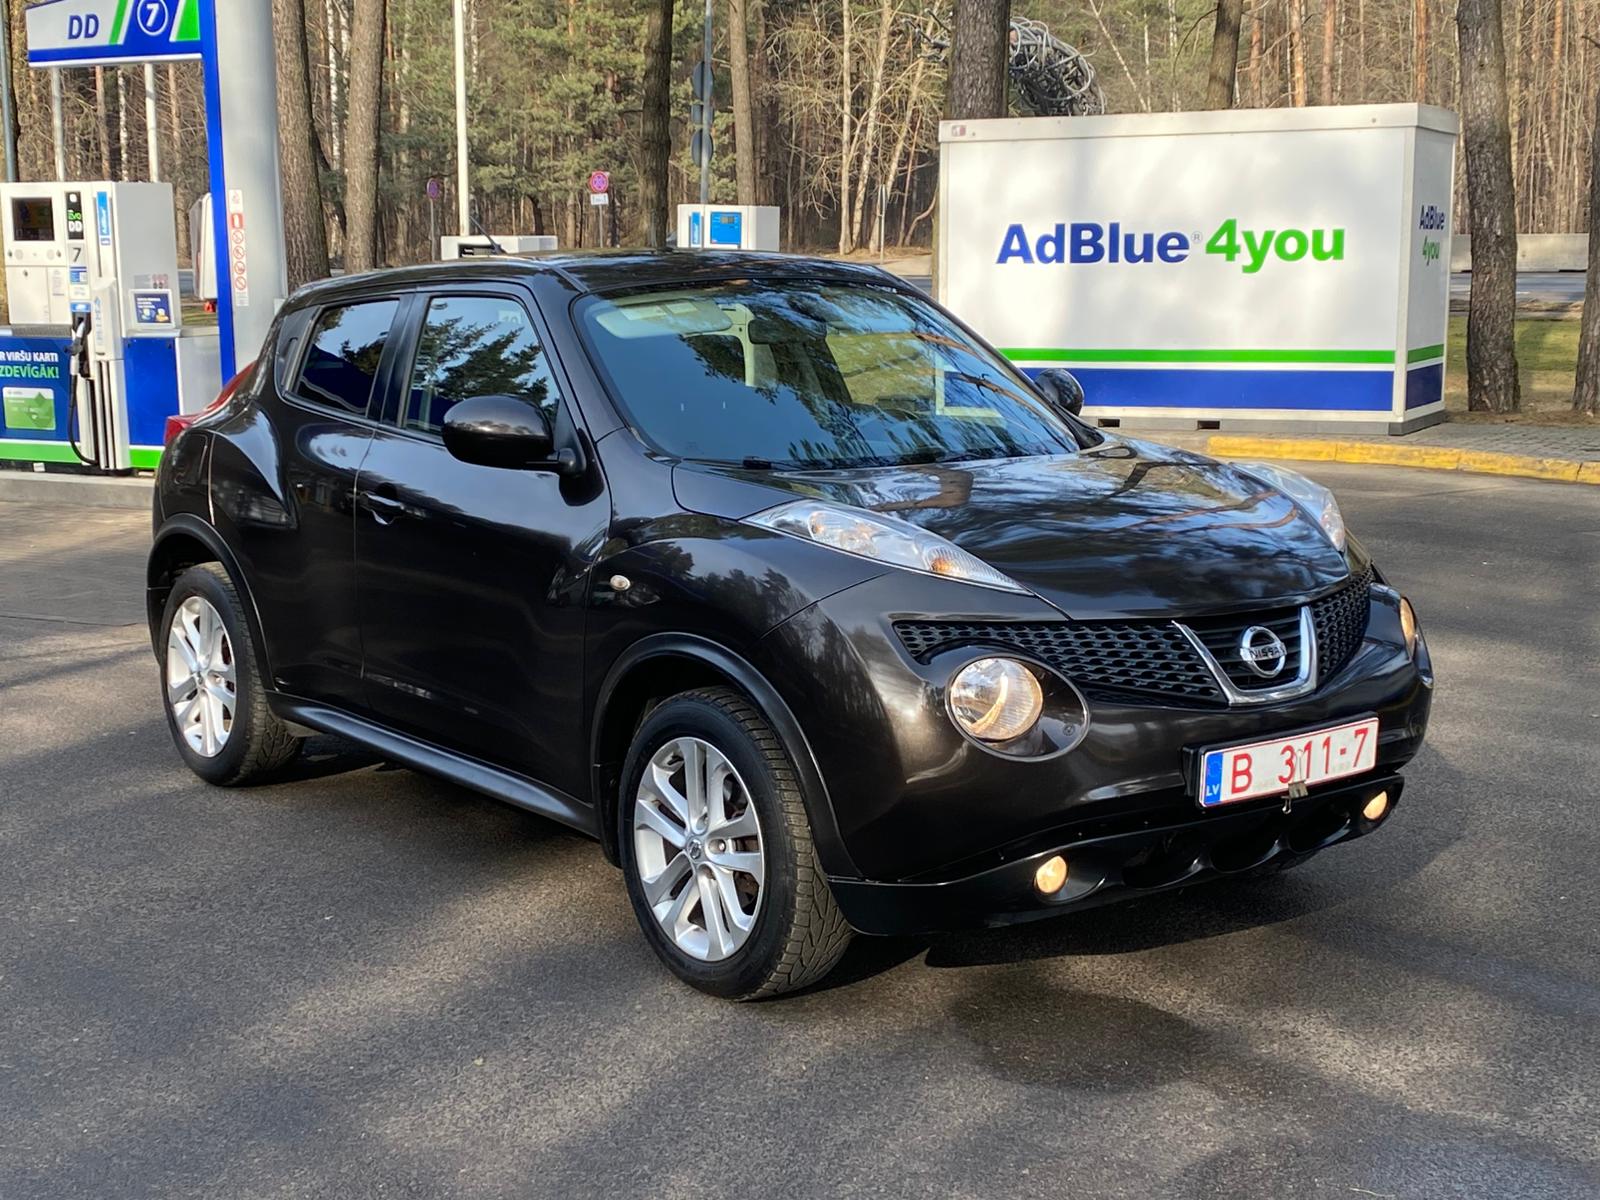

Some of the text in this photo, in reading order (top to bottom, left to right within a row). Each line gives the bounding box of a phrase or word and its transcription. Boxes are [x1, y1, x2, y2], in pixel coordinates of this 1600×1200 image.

[67, 14, 99, 40] DD
[146, 3, 158, 27] 7
[68, 220, 82, 232] DD
[1419, 204, 1445, 230] AdBlue
[72, 247, 82, 262] 7
[1205, 218, 1346, 274] 4you
[1422, 235, 1441, 266] 4you
[6, 350, 32, 361] VIRŠU
[33, 352, 59, 362] KARTI
[1231, 727, 1368, 794] B 311-7
[1206, 784, 1220, 796] LV
